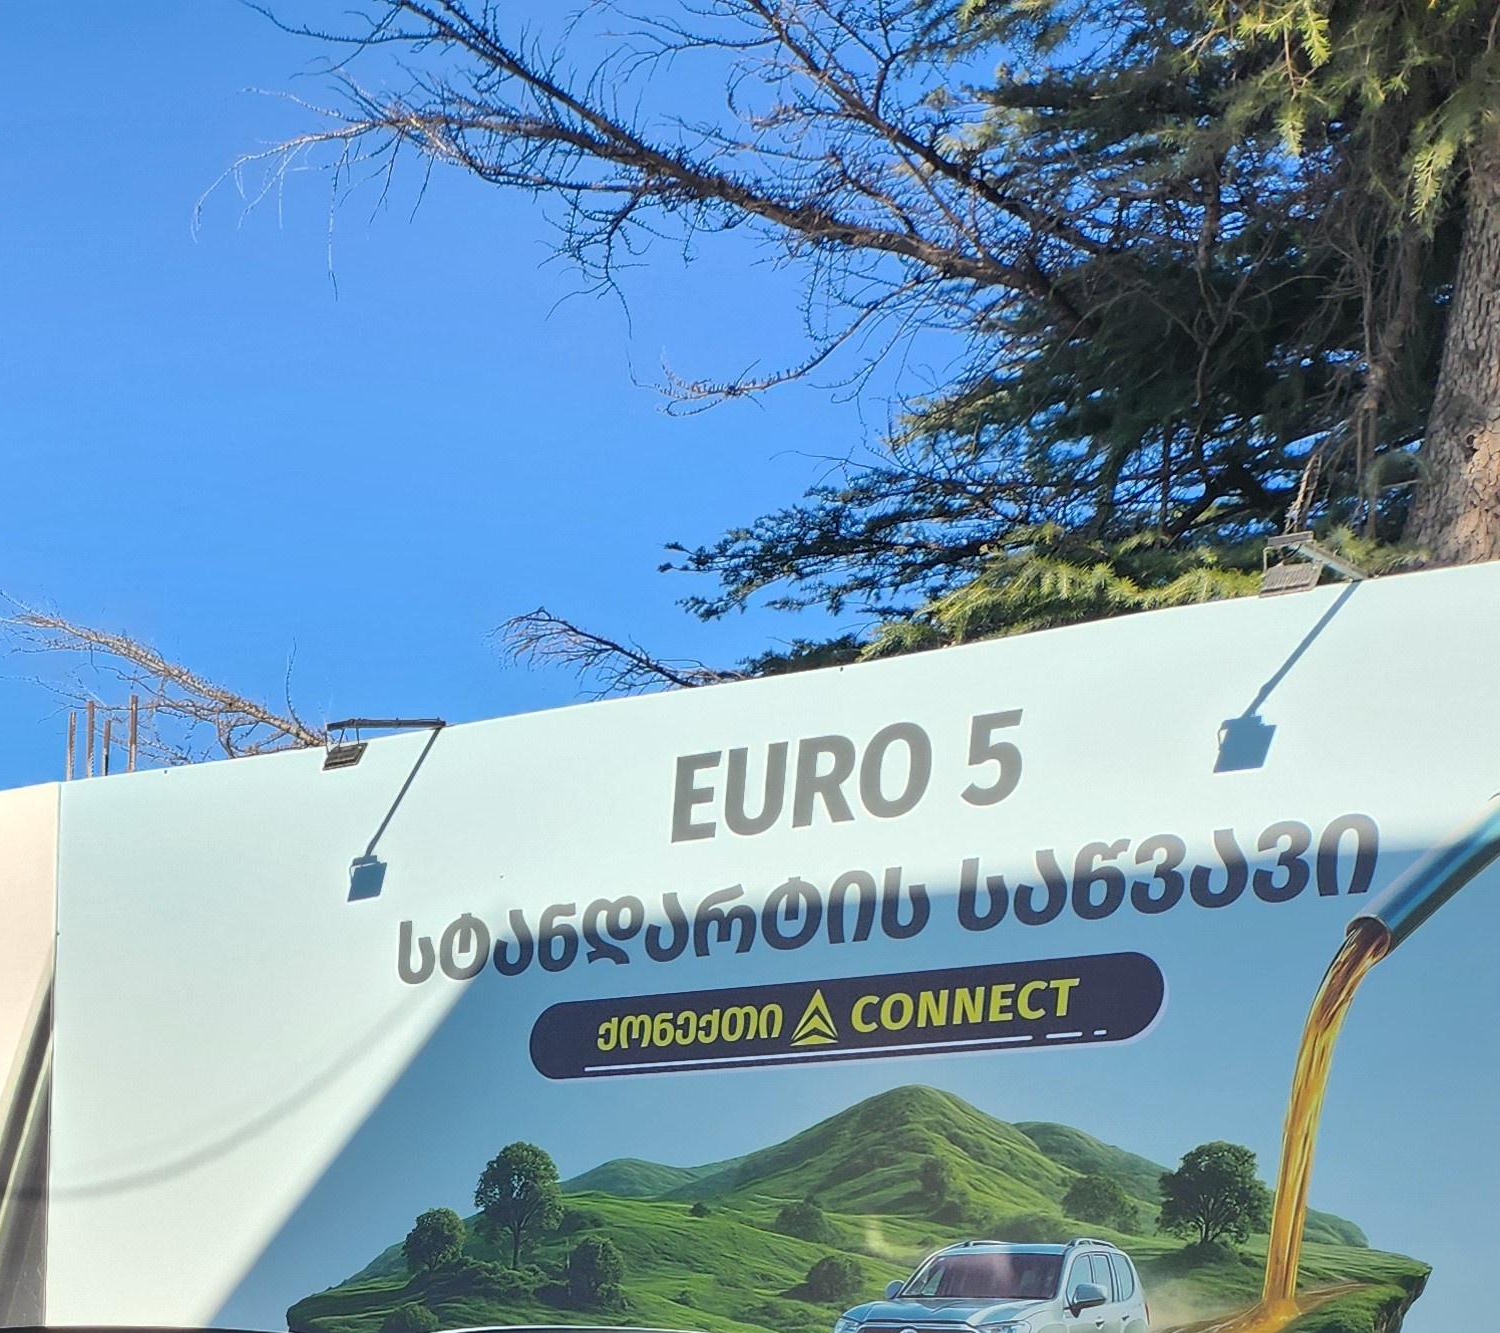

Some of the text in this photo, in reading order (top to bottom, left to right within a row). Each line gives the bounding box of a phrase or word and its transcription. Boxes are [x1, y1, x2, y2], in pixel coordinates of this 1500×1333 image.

[671, 708, 1024, 844] EURO 5
[850, 977, 1081, 1033] CONNECT
